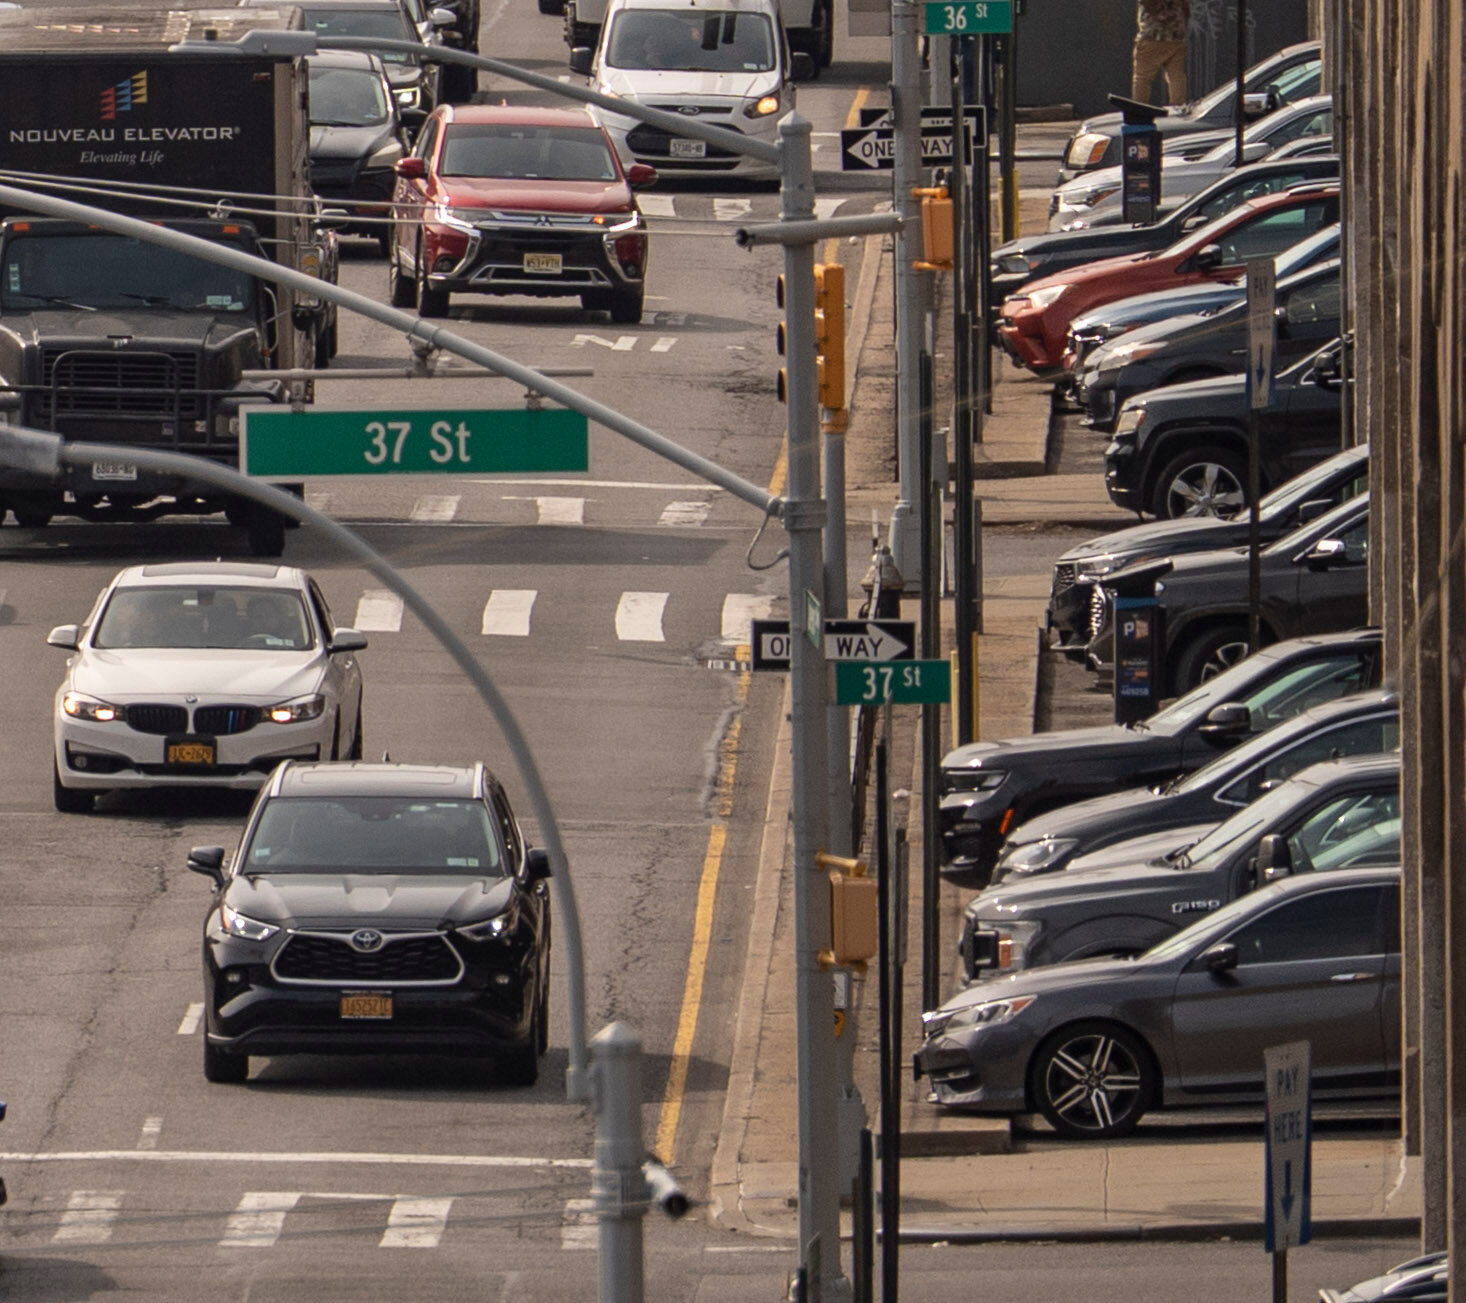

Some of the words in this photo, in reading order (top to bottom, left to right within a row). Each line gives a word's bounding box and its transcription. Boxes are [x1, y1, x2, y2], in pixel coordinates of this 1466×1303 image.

[944, 4, 968, 31] 36
[975, 2, 988, 18] St
[10, 127, 116, 143] NOUVEAU
[79, 149, 137, 167] Elevating
[139, 149, 166, 166] Life
[862, 140, 895, 158] ONE
[920, 138, 954, 156] WAY
[363, 422, 408, 465] 37
[429, 421, 471, 465] St
[836, 636, 884, 657] WAY
[862, 666, 894, 701] 37
[903, 665, 921, 688] St
[1275, 1064, 1300, 1097] PAY
